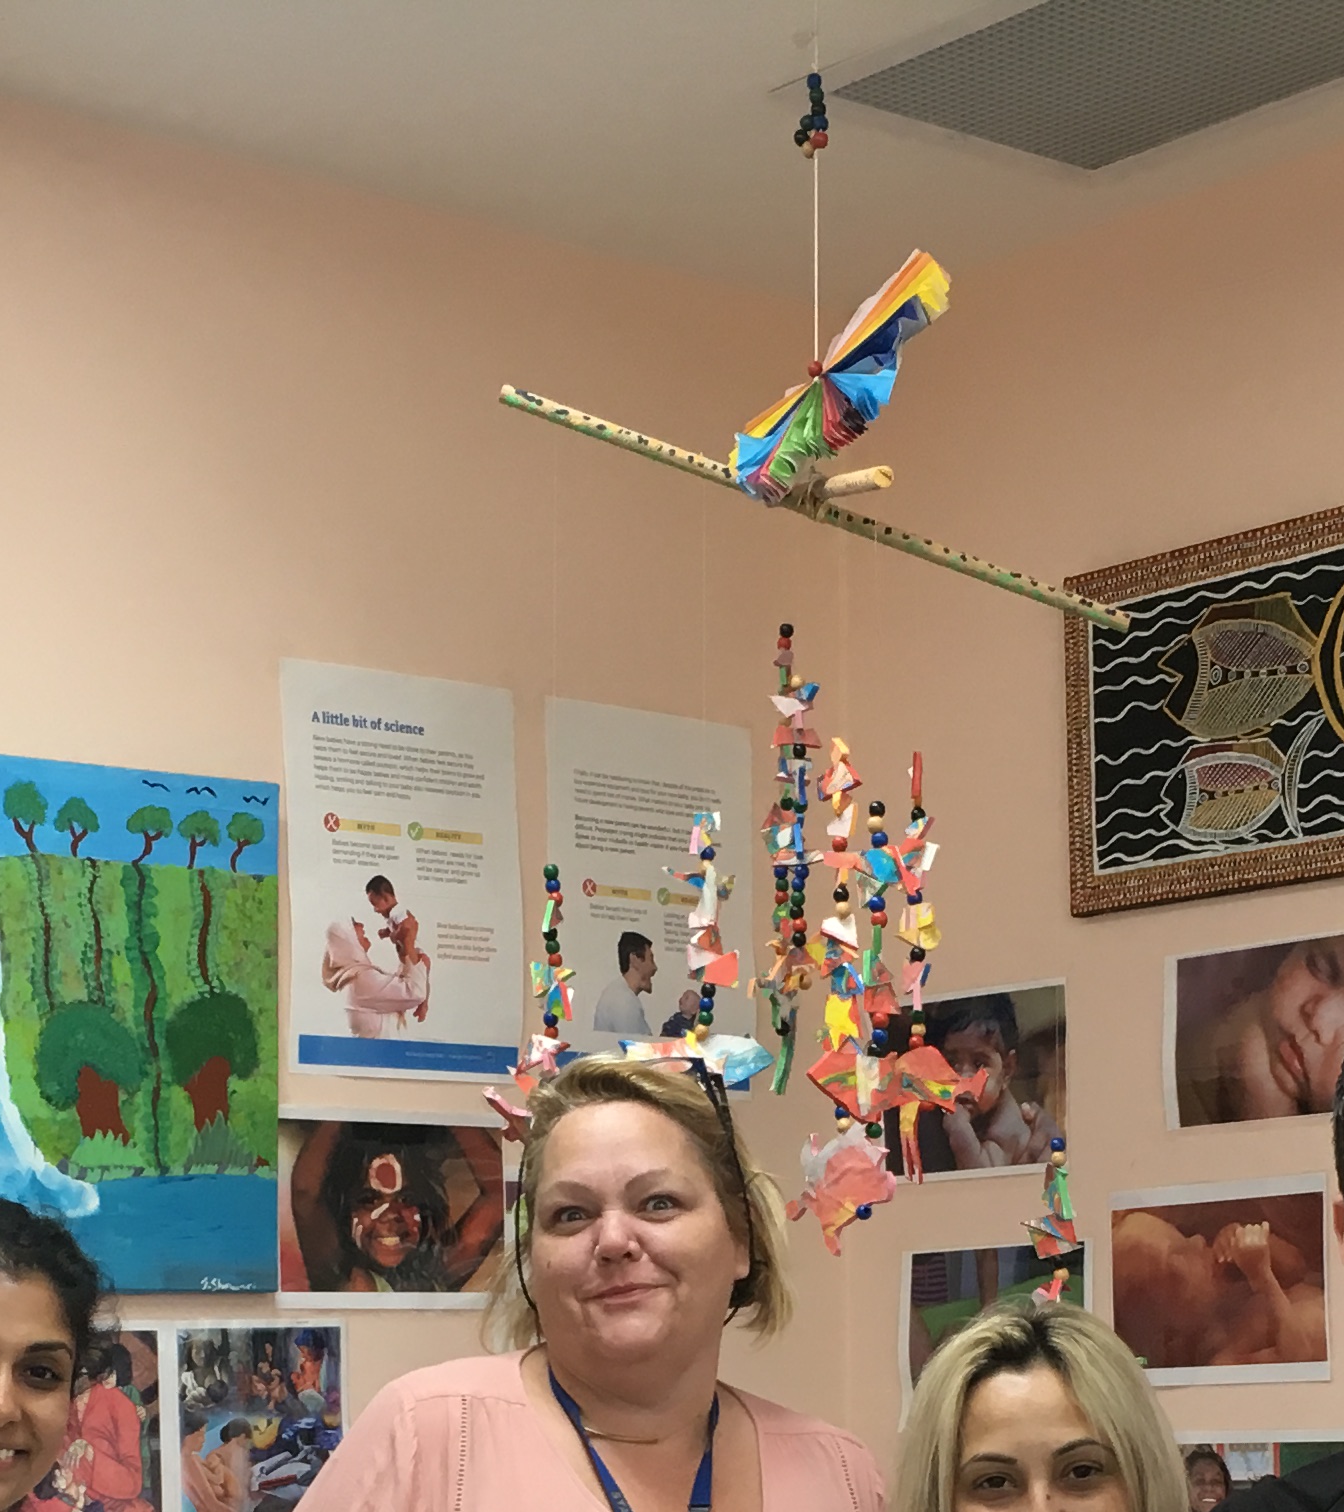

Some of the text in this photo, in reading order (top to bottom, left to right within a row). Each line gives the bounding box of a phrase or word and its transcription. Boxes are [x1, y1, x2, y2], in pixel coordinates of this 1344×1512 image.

[311, 711, 425, 736] A little bit of science
